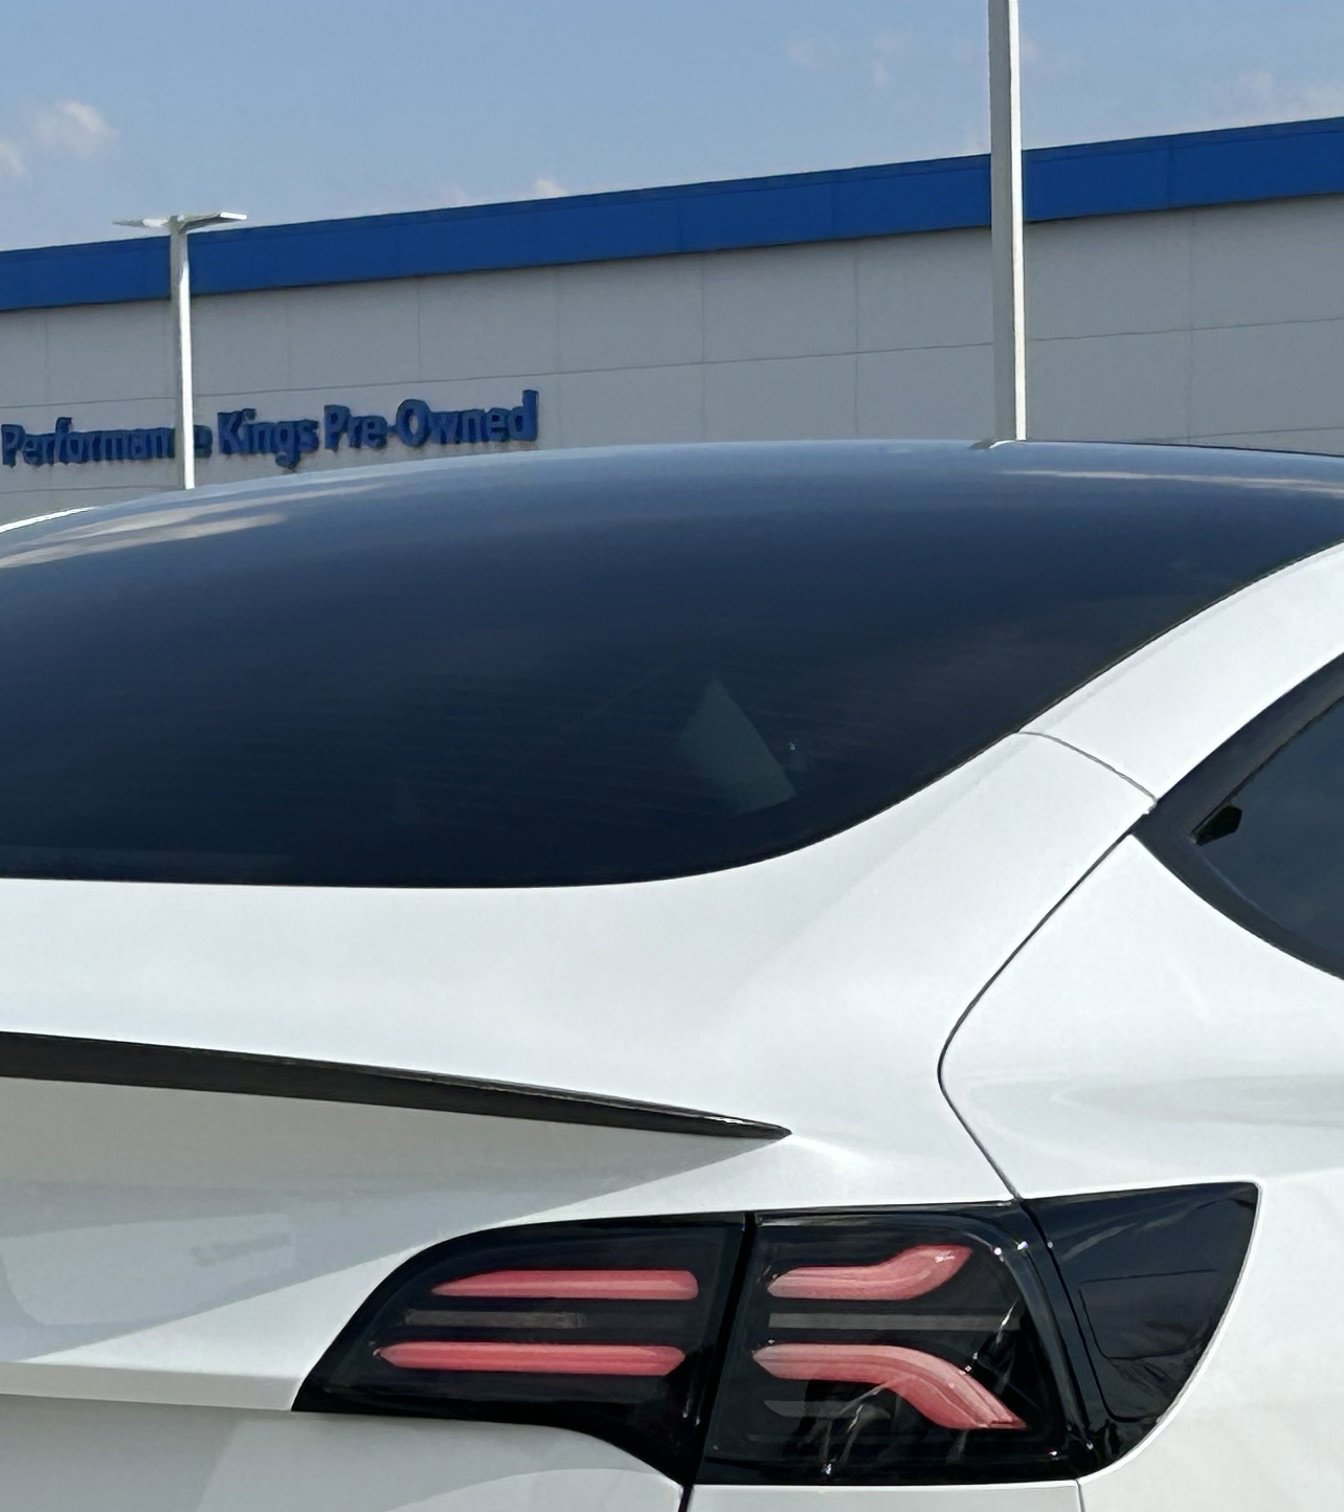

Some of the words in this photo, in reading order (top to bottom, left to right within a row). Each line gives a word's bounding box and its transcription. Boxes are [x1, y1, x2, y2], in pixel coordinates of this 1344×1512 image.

[1, 416, 212, 467] Performane
[217, 407, 320, 470] Kings
[324, 389, 539, 451] Pre-Owned
